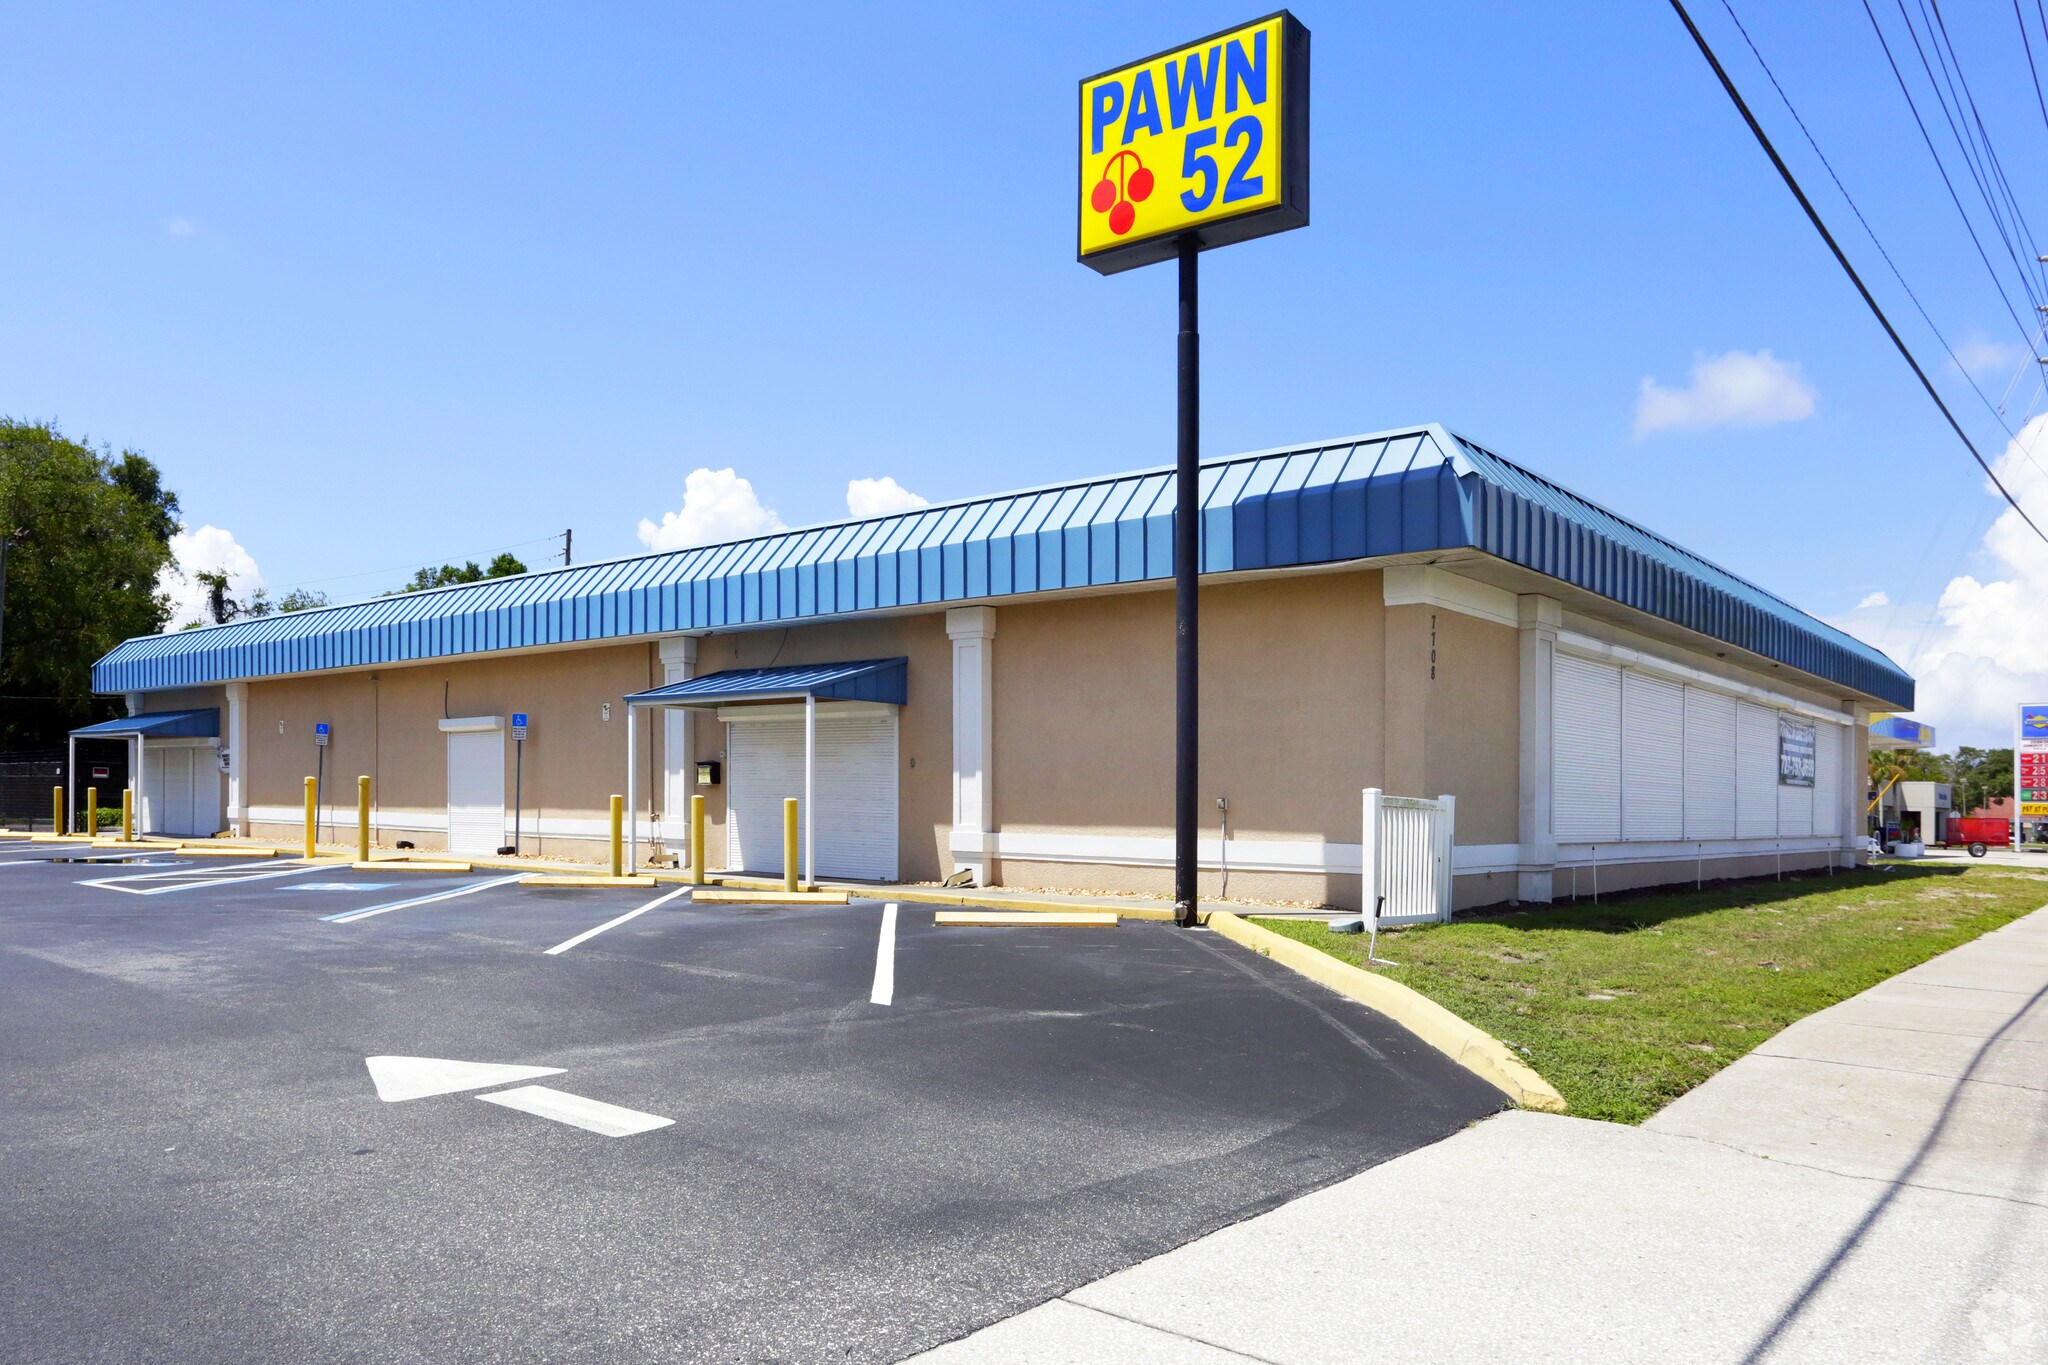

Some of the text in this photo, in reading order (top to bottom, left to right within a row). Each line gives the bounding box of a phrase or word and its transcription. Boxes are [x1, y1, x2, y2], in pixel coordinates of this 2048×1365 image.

[1091, 29, 1268, 155] PAWN
[1179, 114, 1263, 213] 52
[2022, 805, 2033, 813] PAY
